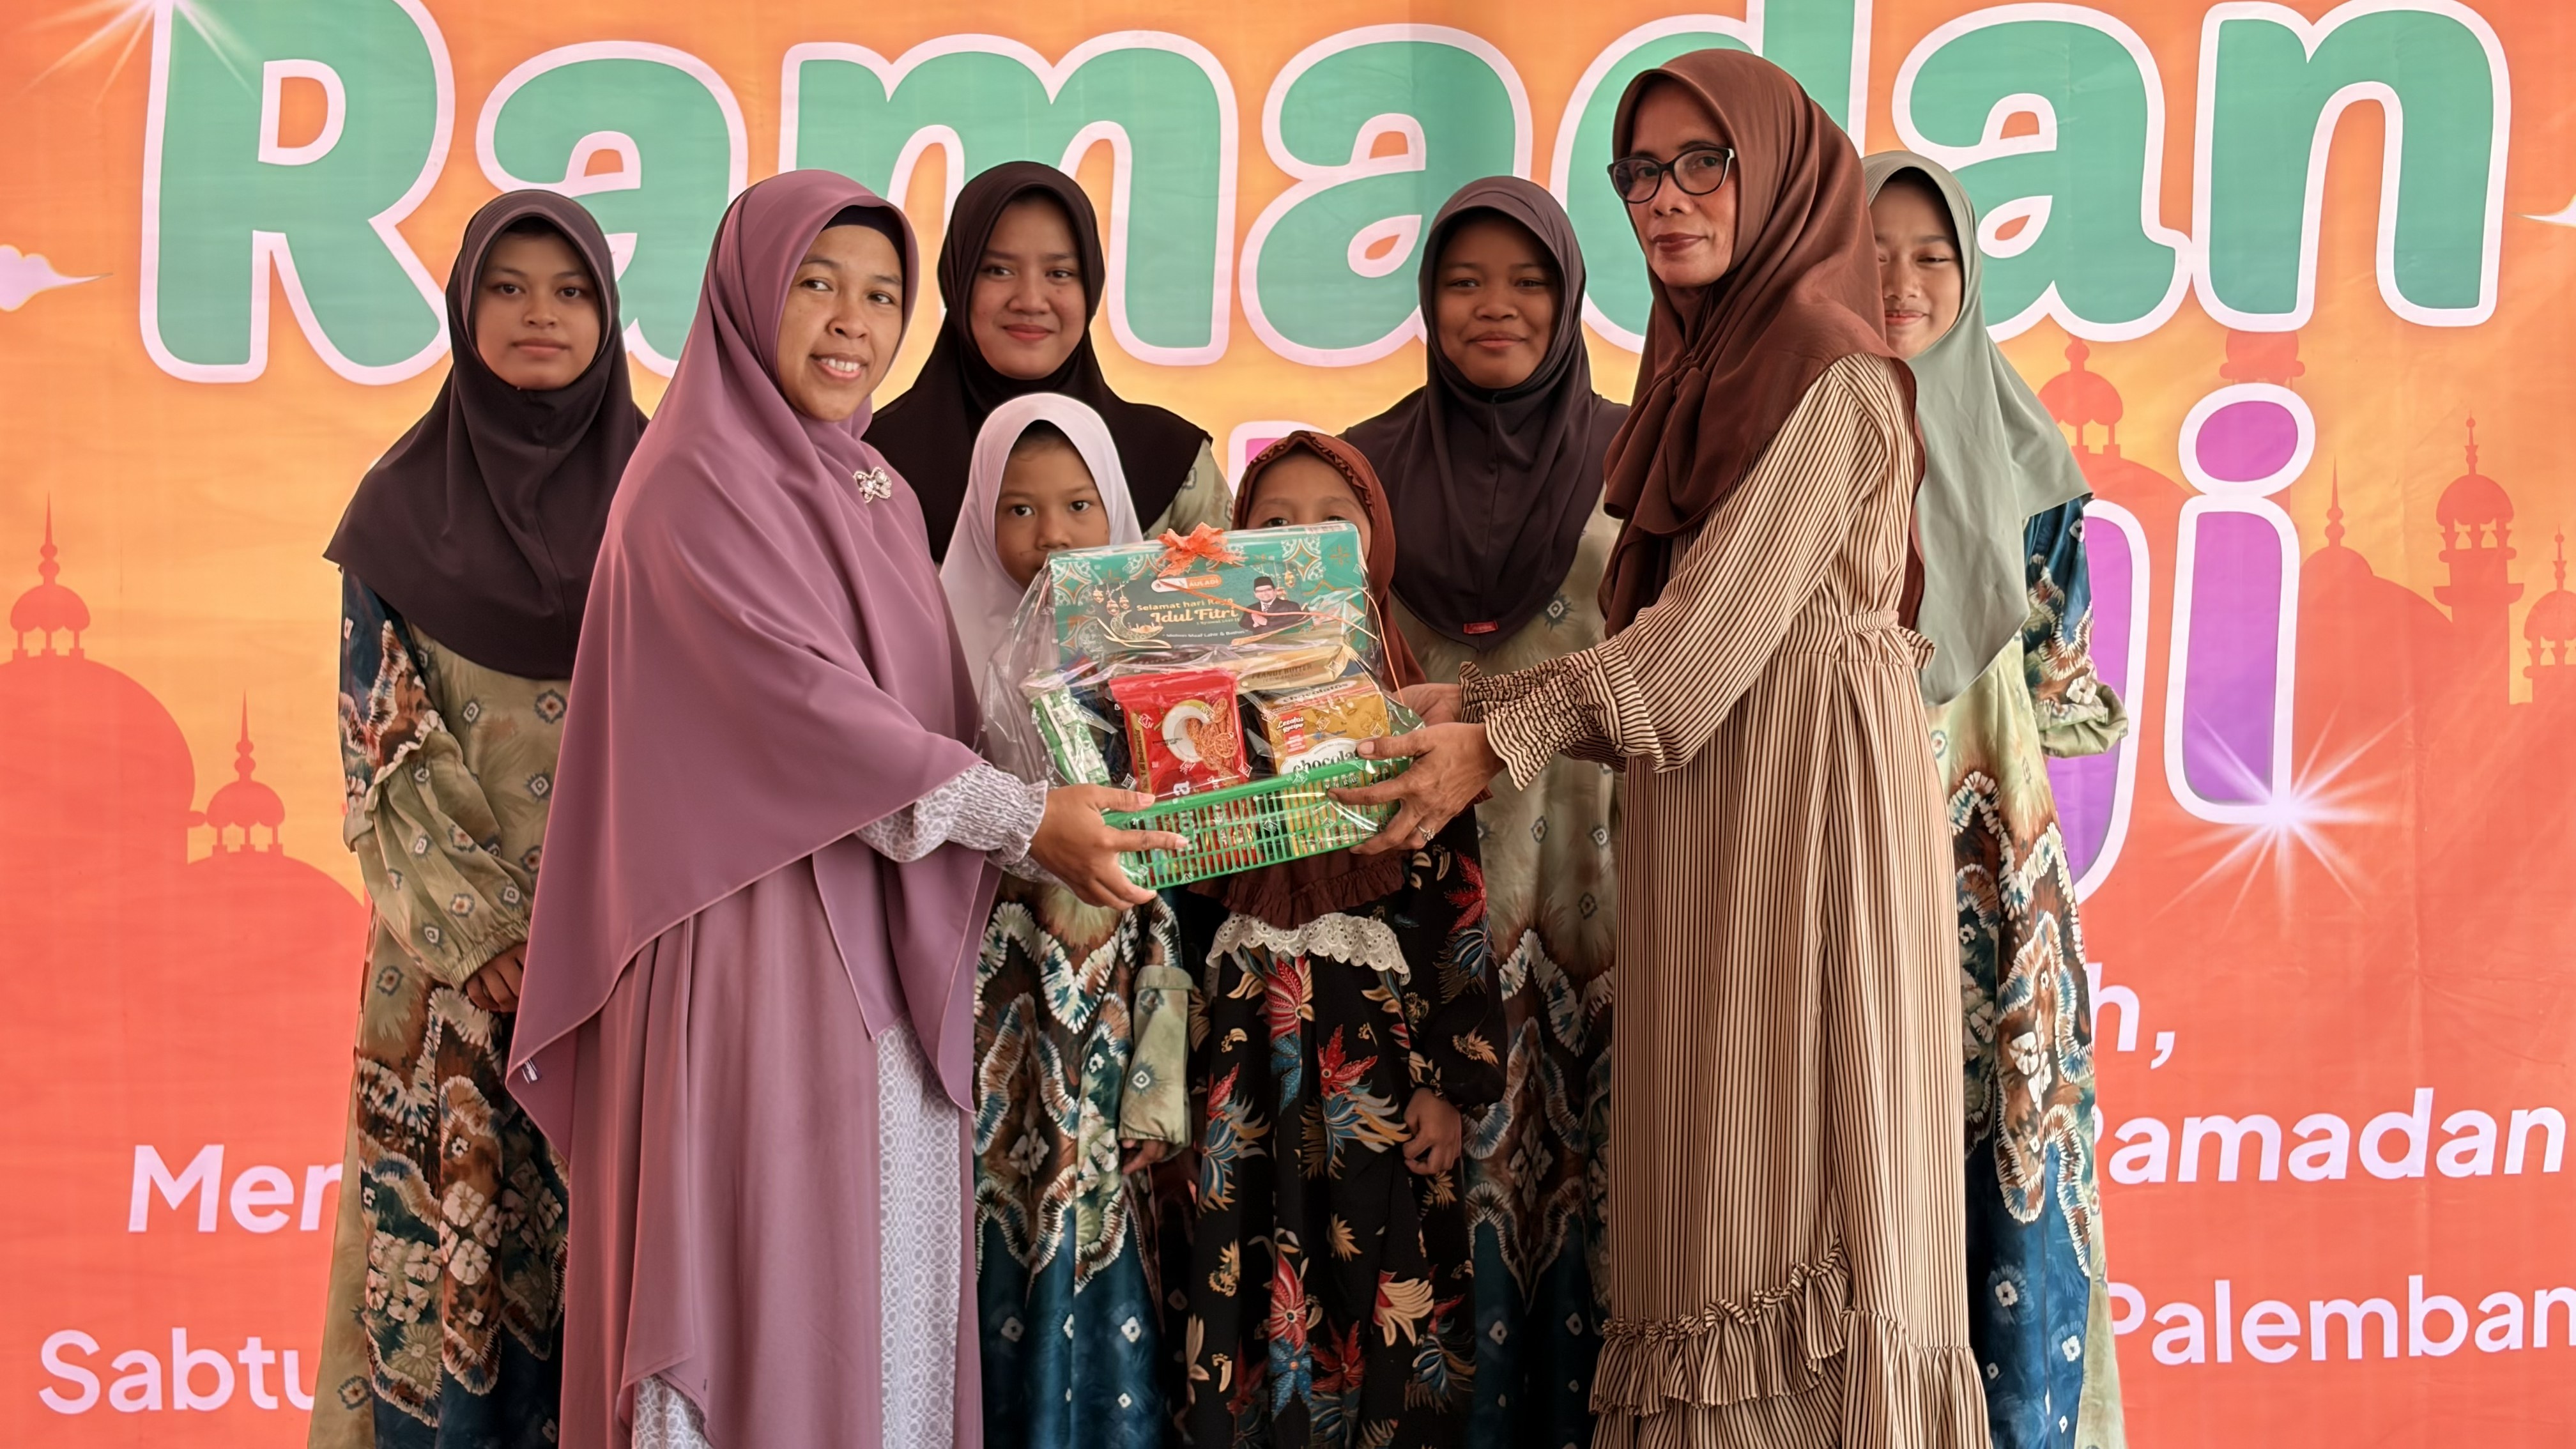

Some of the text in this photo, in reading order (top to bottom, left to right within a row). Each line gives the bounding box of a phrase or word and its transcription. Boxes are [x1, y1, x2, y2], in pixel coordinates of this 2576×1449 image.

[1136, 602, 1181, 611] Selamat
[1183, 600, 1205, 608] hari
[1150, 606, 1239, 623] Idul Fitri
[1134, 729, 1144, 763] Indonesia
[1293, 751, 1356, 774] chocola
[2095, 1087, 2566, 1185] amadan
